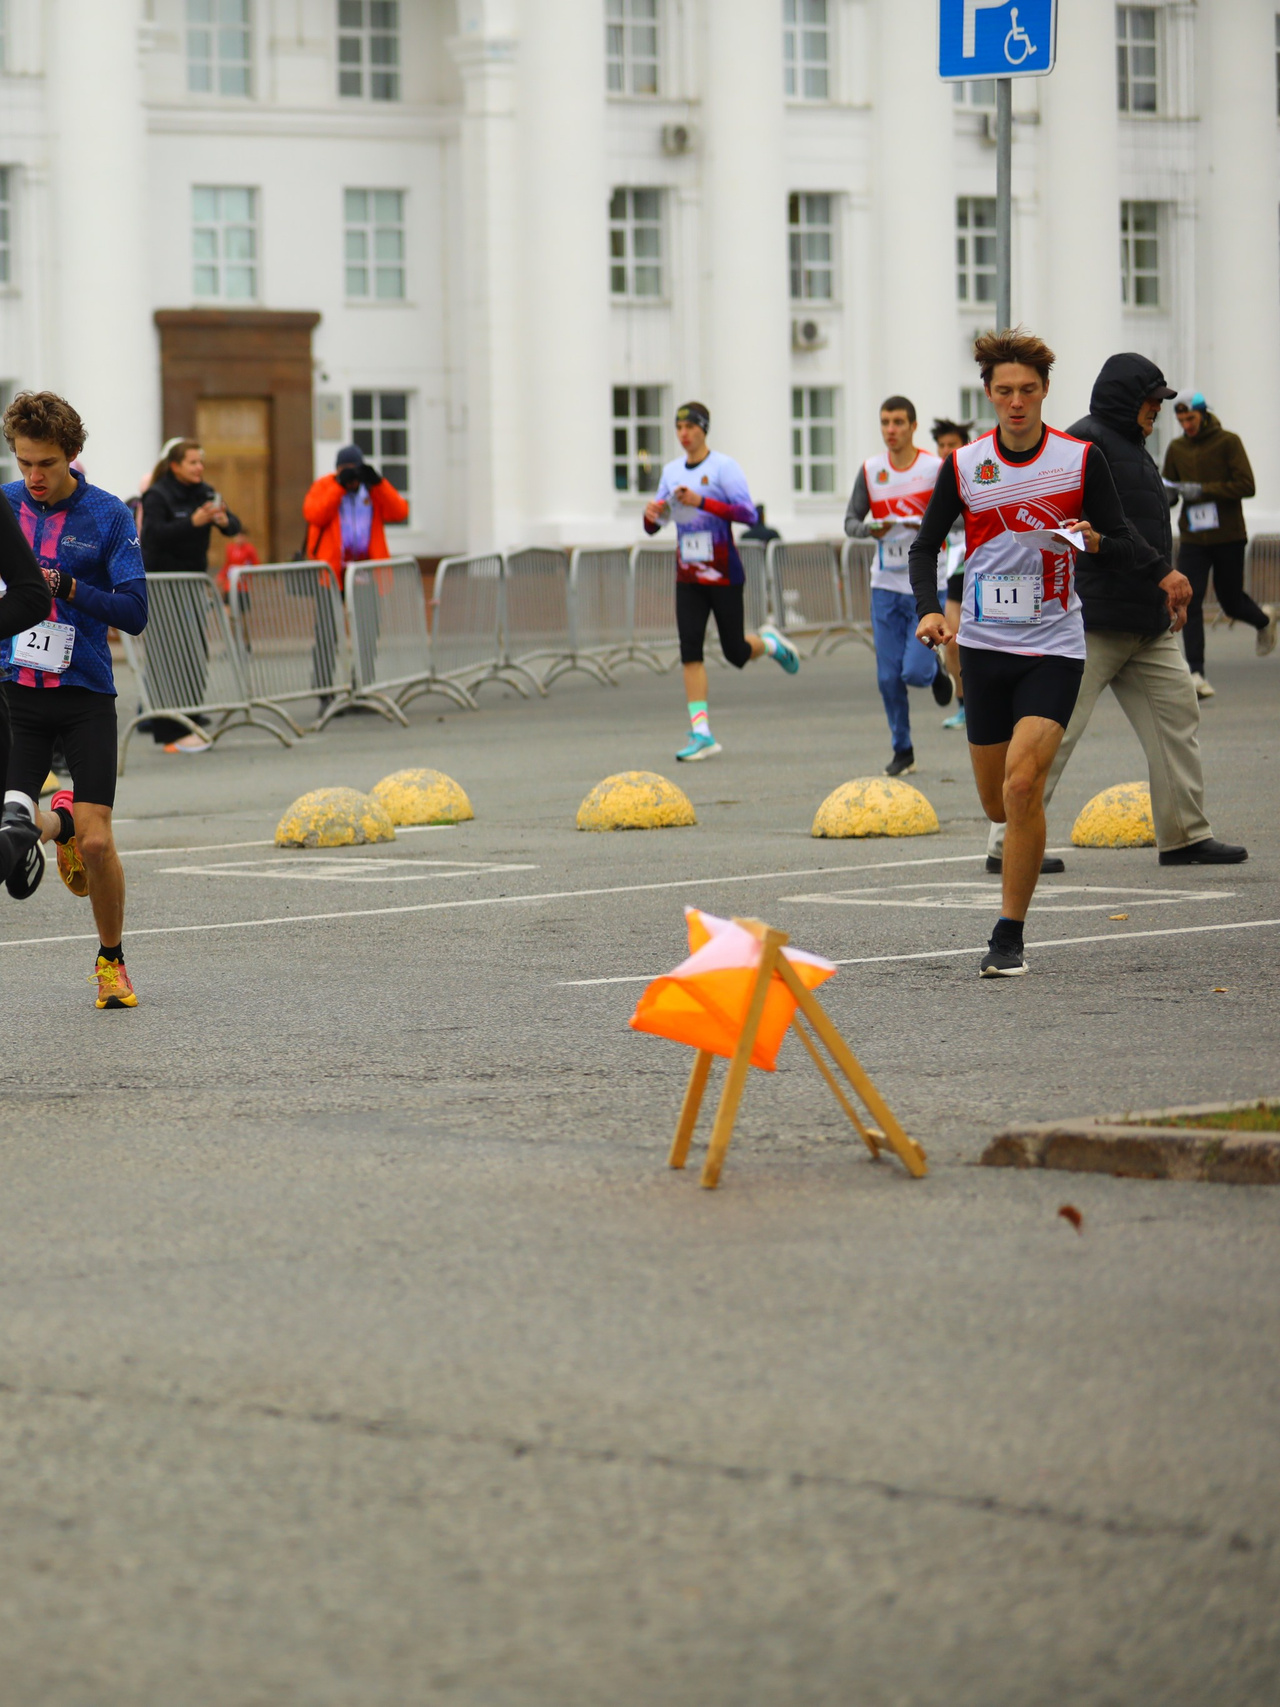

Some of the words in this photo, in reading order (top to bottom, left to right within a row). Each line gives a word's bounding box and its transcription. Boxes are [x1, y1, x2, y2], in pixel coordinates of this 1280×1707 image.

[1015, 506, 1046, 531] Run
[994, 587, 1018, 604] 1.1
[26, 631, 51, 652] 2.1
